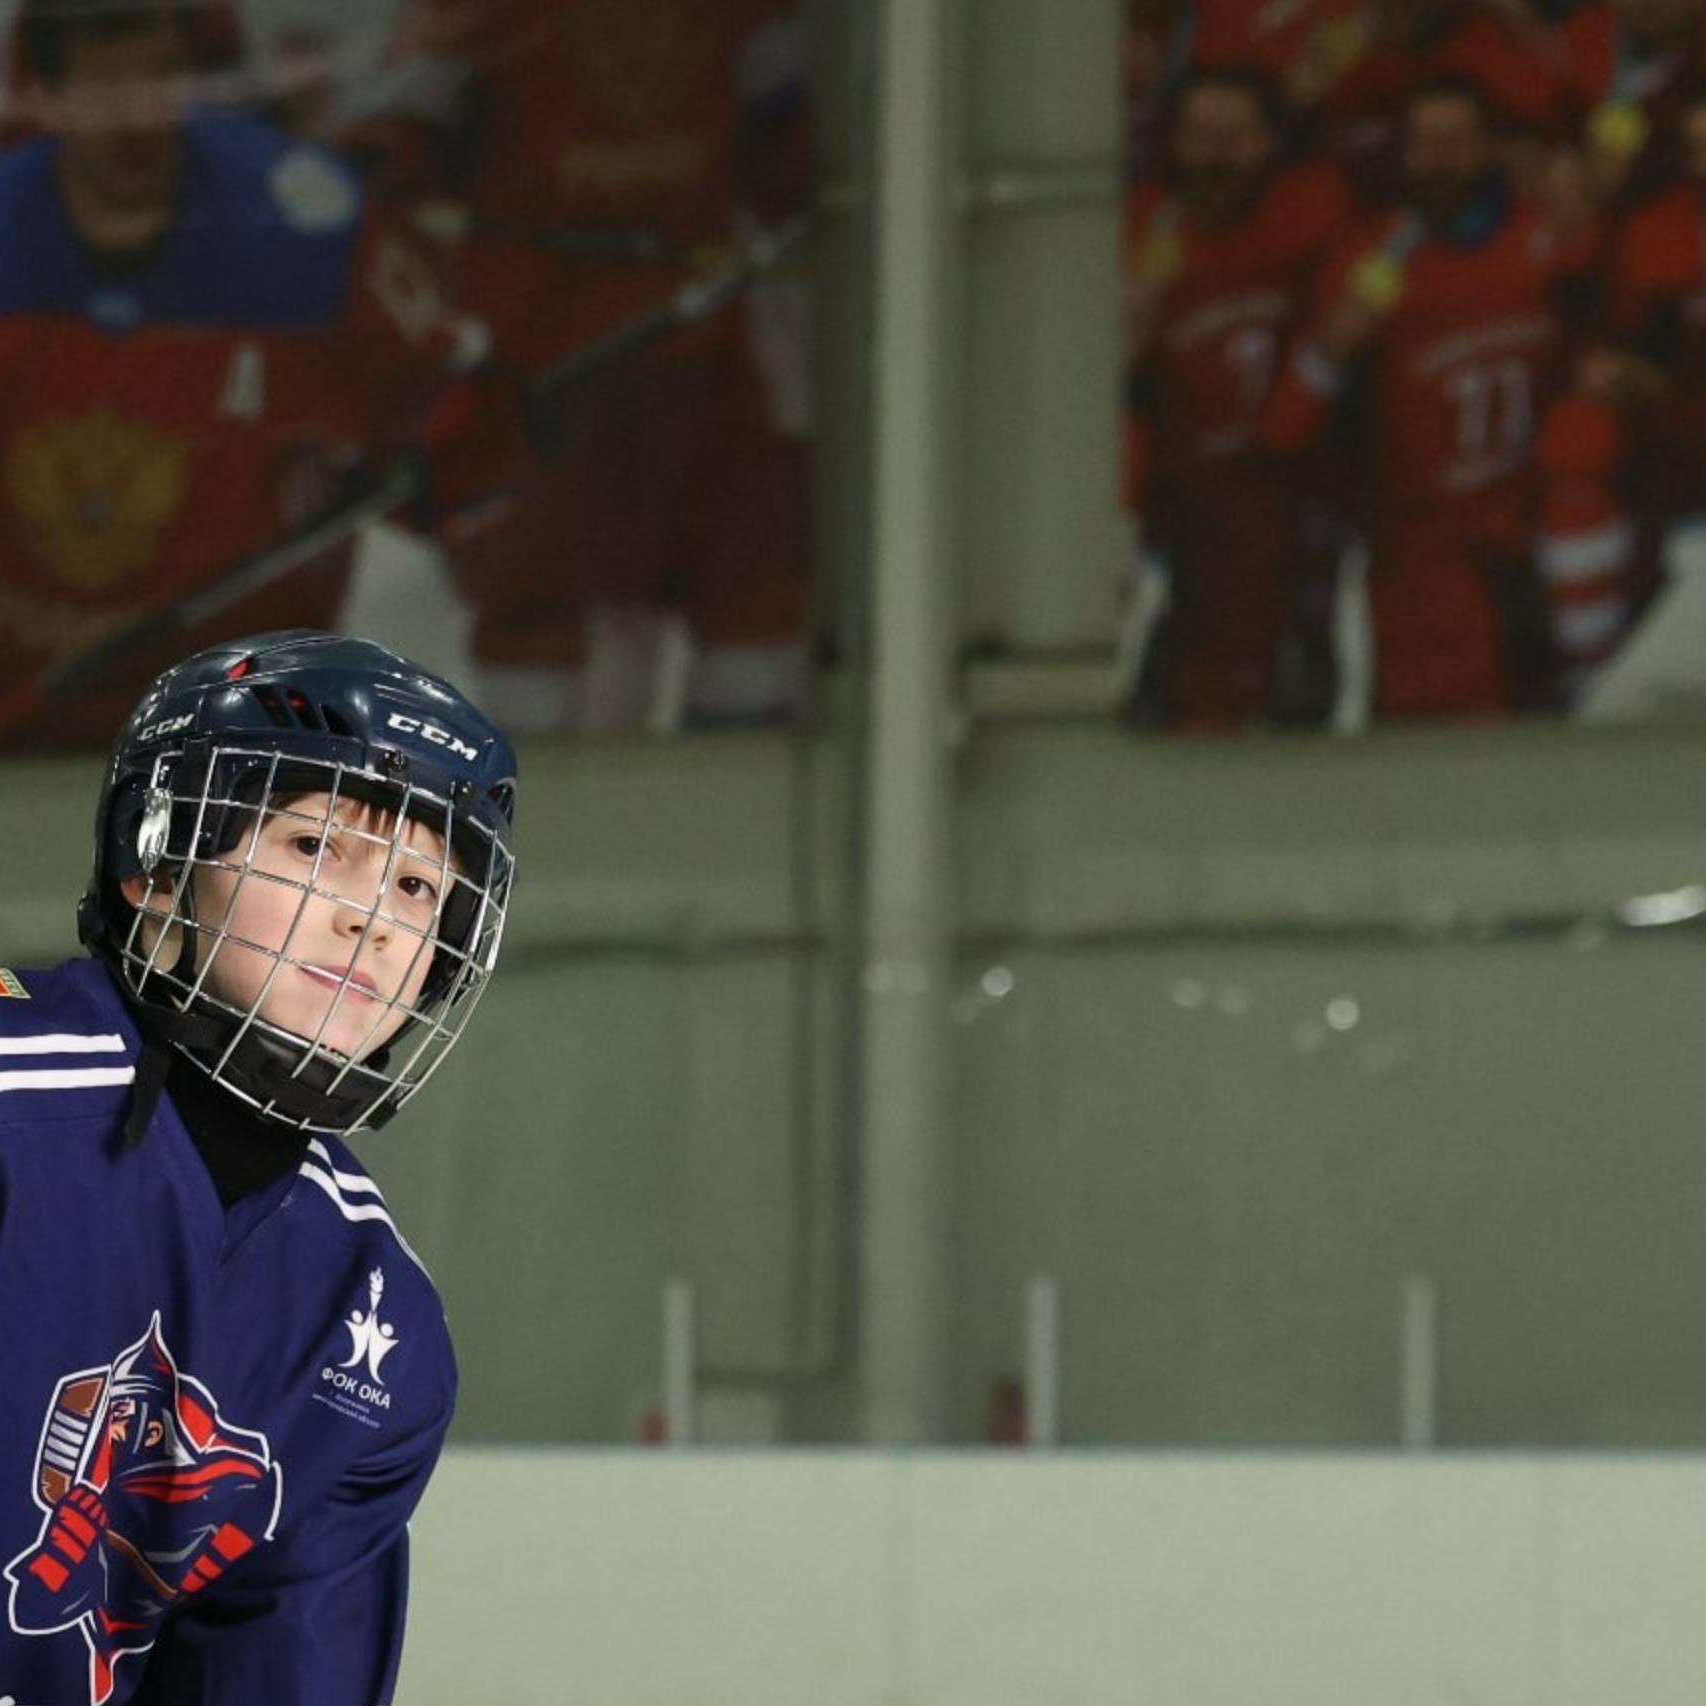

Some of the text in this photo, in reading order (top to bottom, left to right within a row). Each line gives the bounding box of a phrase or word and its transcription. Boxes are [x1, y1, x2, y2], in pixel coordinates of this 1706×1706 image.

[136, 712, 195, 741] CCM
[387, 712, 479, 762] CCM
[321, 1366, 358, 1395] ФОК
[358, 1383, 391, 1410] ОКА
